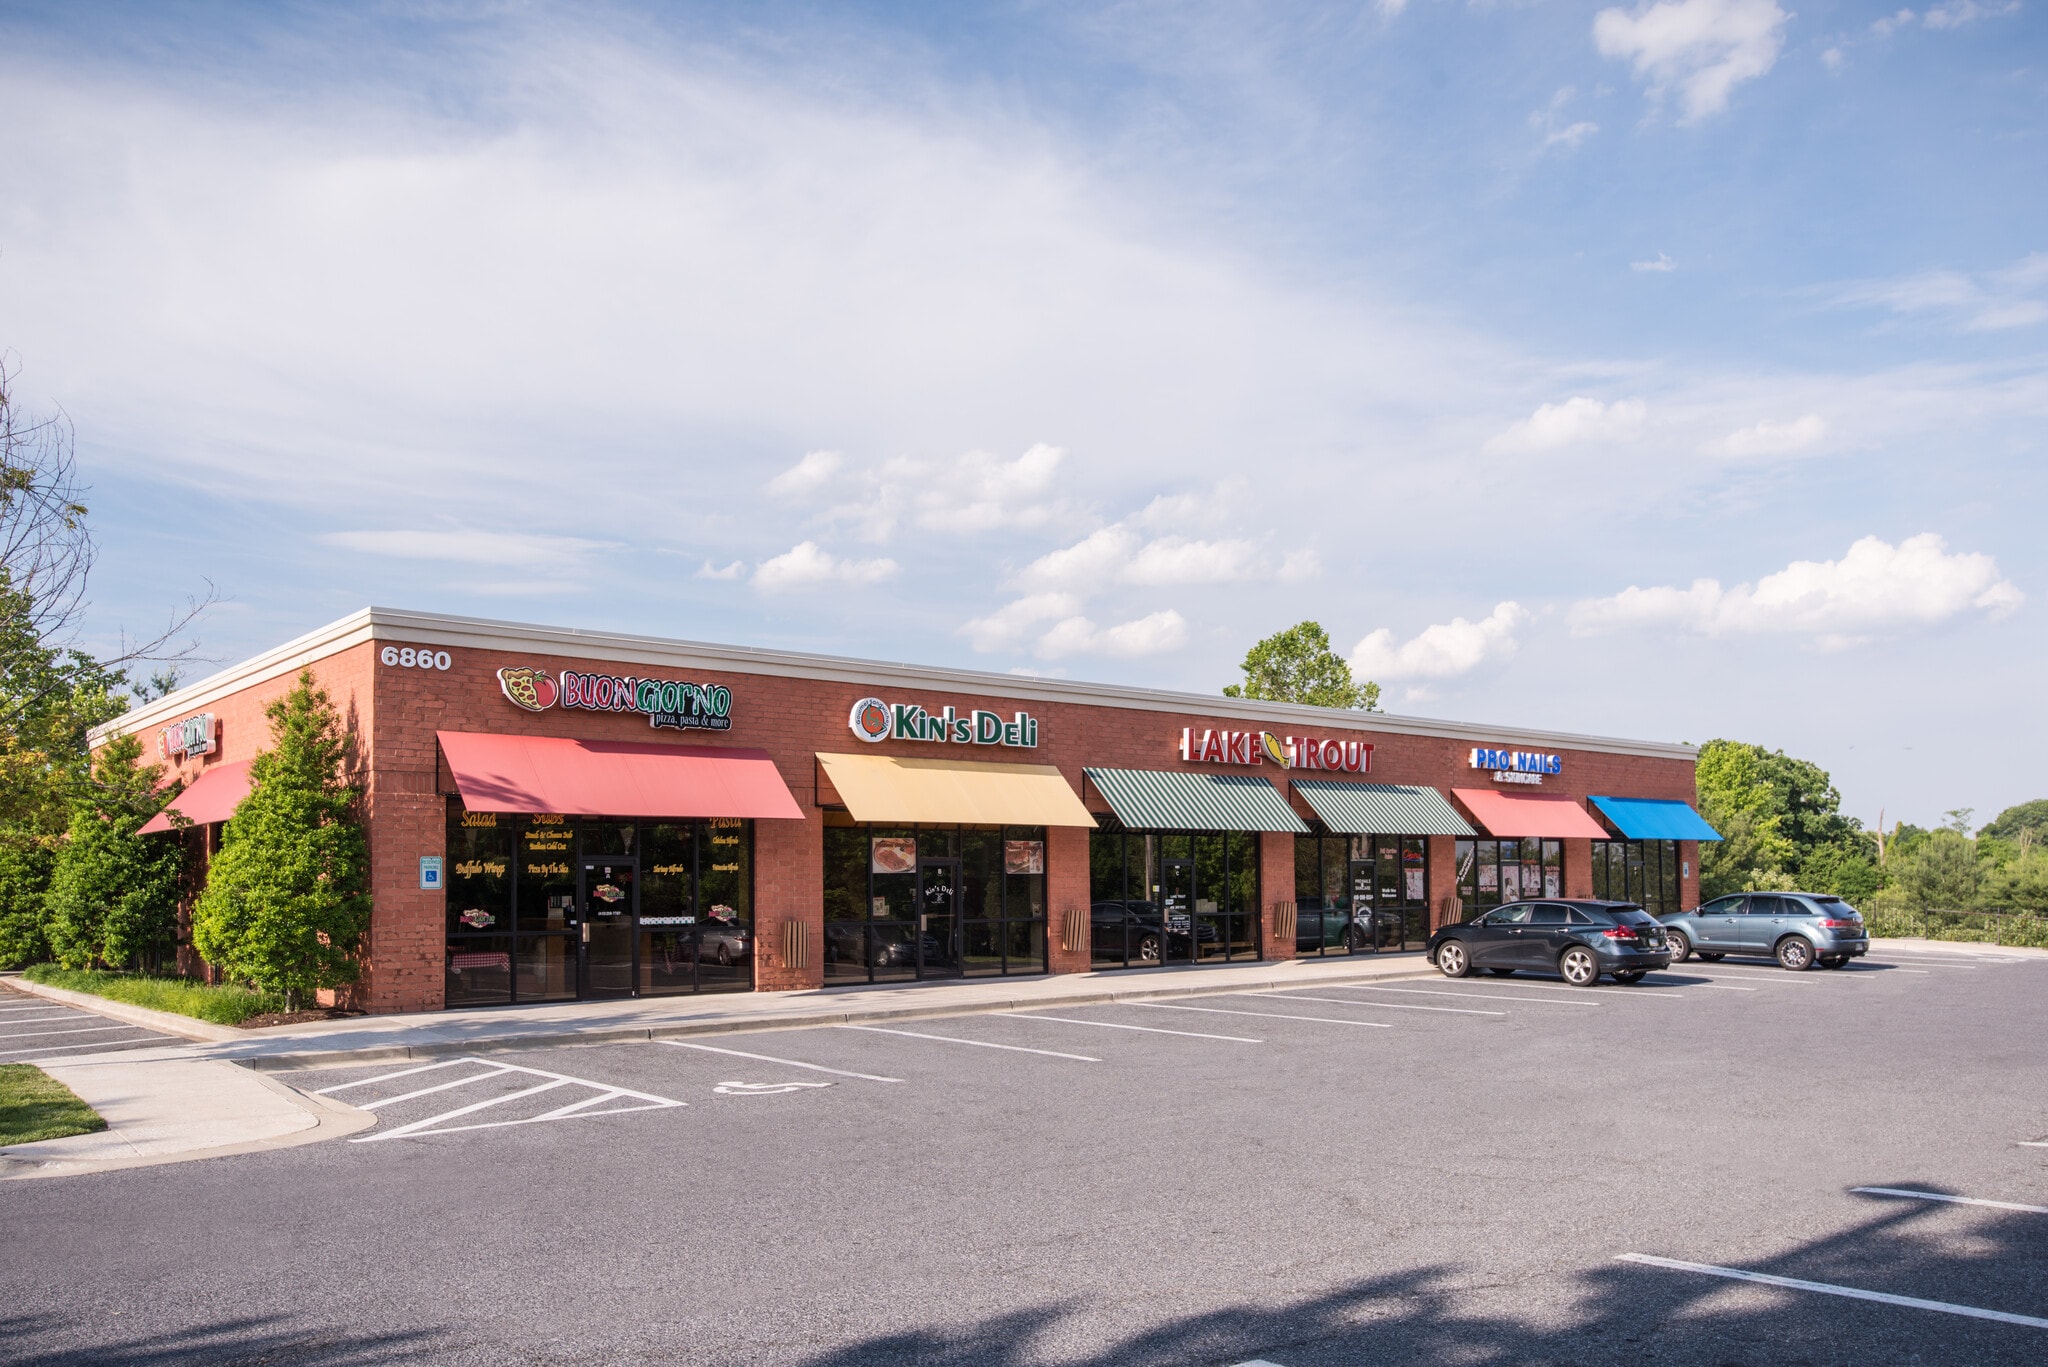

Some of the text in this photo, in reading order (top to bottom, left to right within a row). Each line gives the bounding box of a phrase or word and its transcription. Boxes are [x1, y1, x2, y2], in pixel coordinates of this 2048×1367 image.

[381, 646, 452, 671] 6860
[680, 716, 699, 727] pasta
[700, 715, 709, 726] &
[710, 718, 729, 727] more
[893, 703, 1038, 748] Kin's Deli
[1183, 727, 1375, 773] LAKE TROUT
[1472, 748, 1562, 775] PRO NAILS
[1494, 770, 1543, 785] & SKINCARE
[461, 810, 497, 827] Salad
[455, 860, 506, 879] Buffalo Wings
